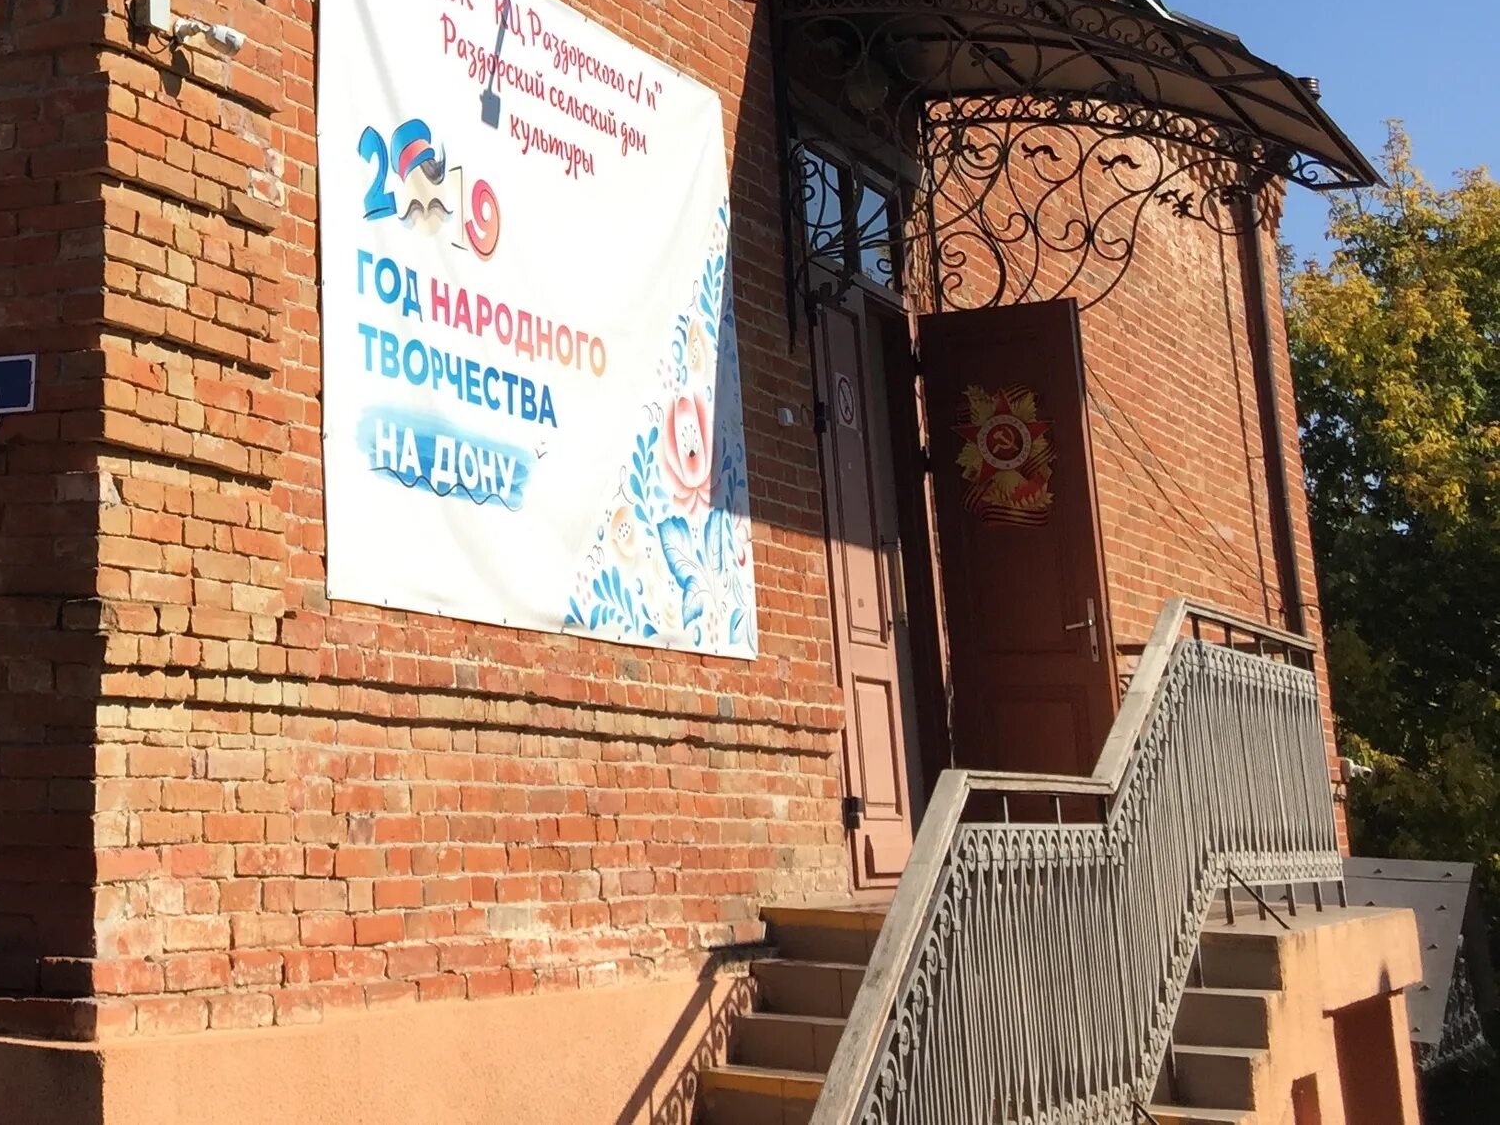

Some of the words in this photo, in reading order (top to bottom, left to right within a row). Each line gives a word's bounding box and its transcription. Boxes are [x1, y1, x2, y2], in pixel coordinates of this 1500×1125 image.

[440, 12, 545, 101] Раздорский
[549, 85, 617, 138] сельский
[621, 123, 648, 157] дом
[527, 8, 624, 92] Раздорского
[510, 113, 595, 179] культуры
[357, 249, 424, 323] ГОД
[431, 277, 607, 377] НАРОДНОГО
[358, 321, 559, 428] ТВОРЧЕСТВА
[375, 420, 423, 475] НА
[430, 433, 517, 496] ДОНУ
